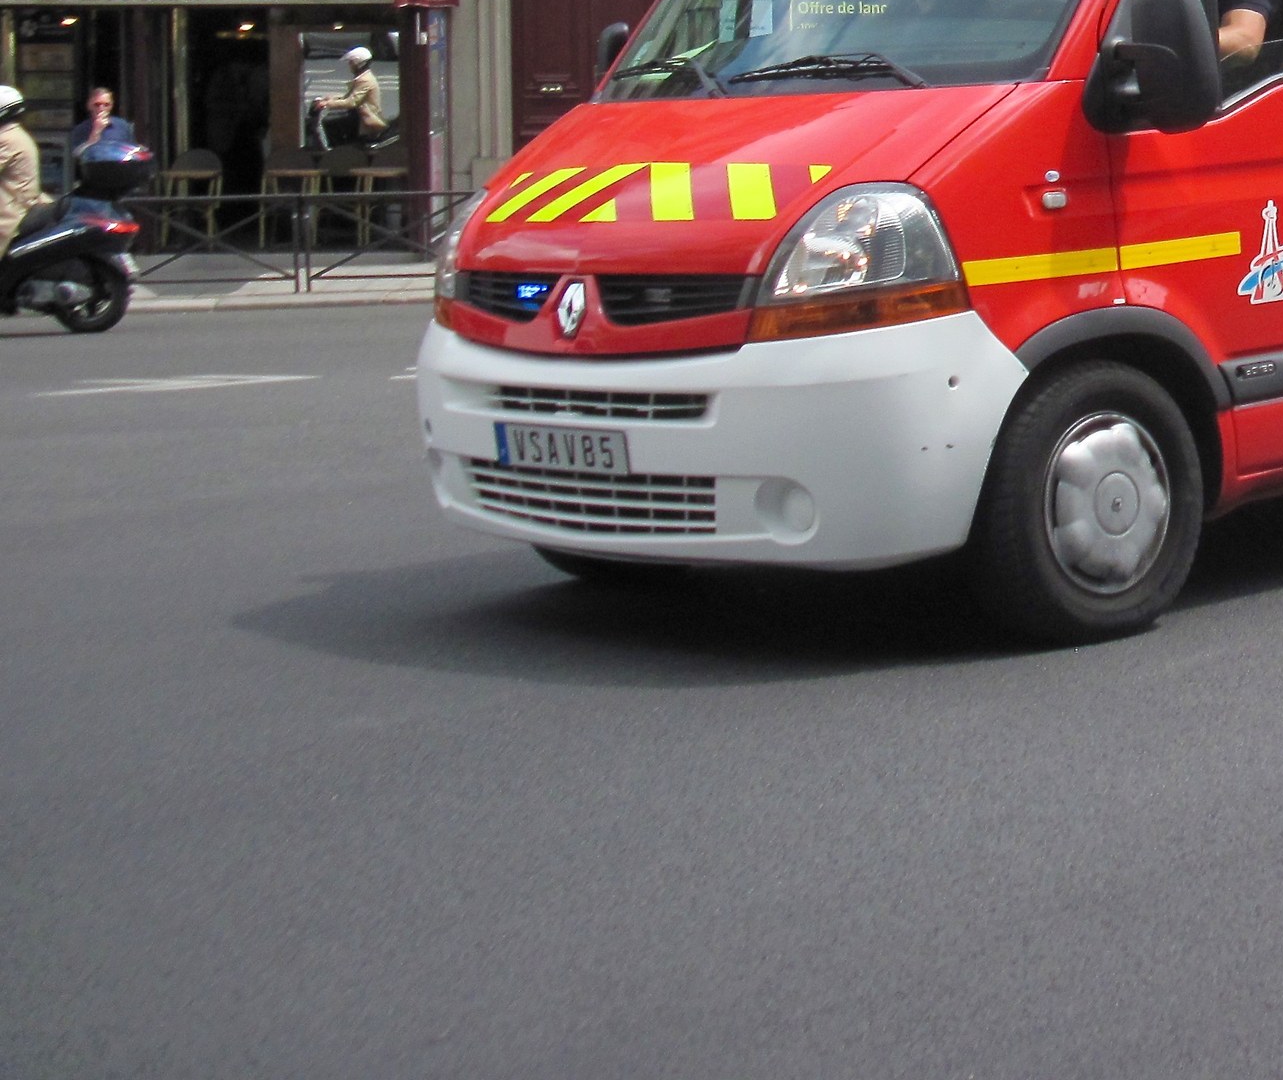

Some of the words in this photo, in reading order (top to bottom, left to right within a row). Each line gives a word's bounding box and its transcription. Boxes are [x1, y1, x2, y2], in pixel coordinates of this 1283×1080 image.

[798, 1, 835, 15] Offre
[837, 1, 855, 15] de
[513, 429, 614, 469] VSAV85
